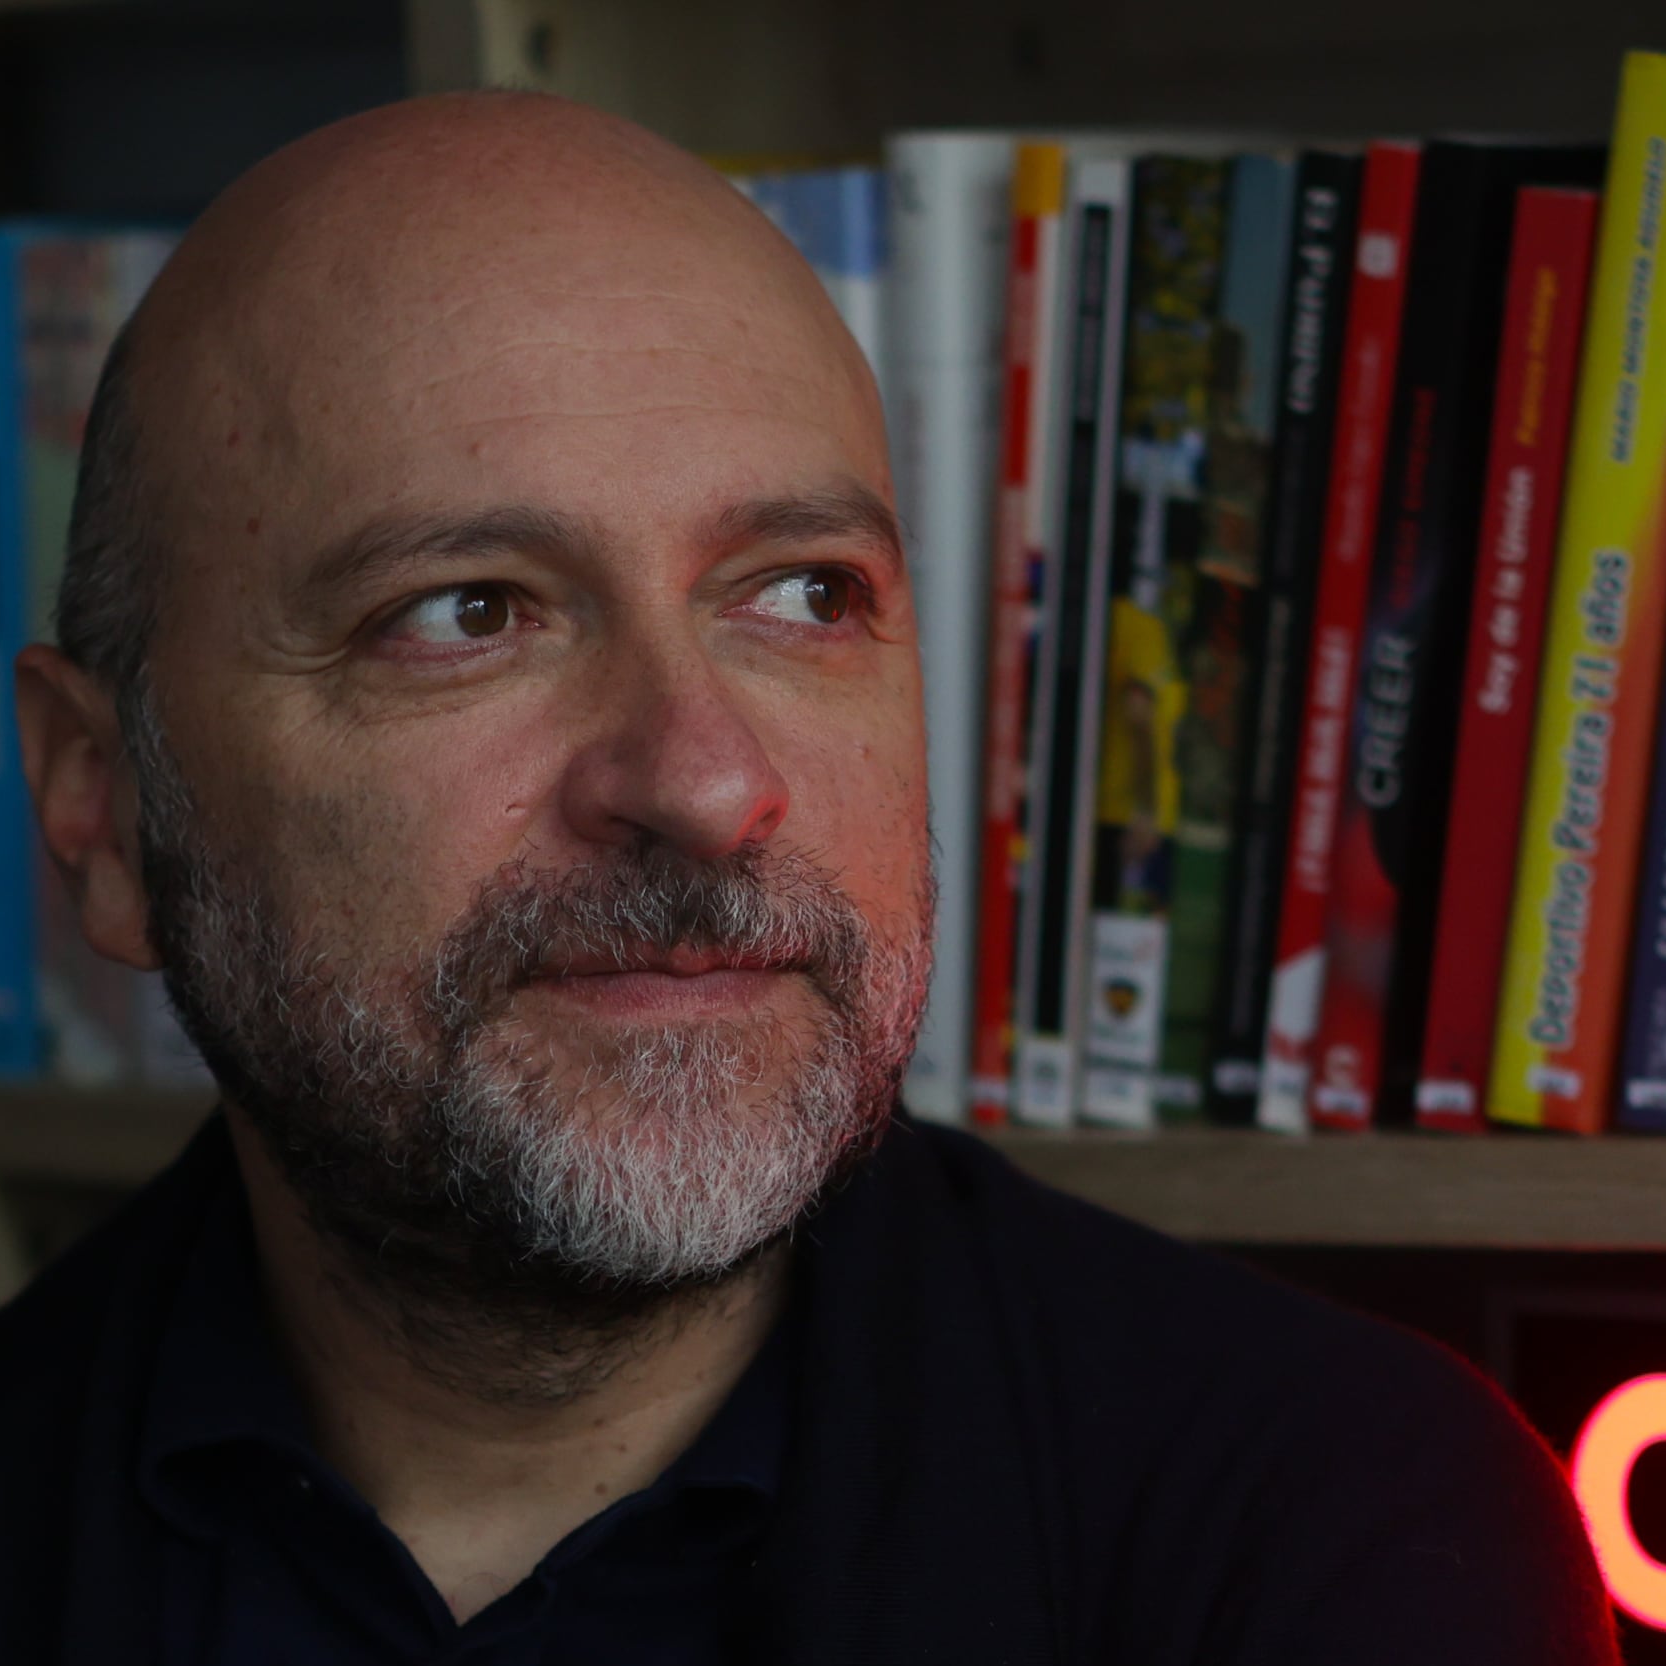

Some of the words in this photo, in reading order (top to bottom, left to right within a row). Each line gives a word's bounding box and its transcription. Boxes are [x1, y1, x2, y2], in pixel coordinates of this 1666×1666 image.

[1582, 550, 1630, 642] años
[1355, 632, 1417, 808] CREER
[1553, 712, 1607, 852] Pereira
[1528, 863, 1587, 1046] Deportivo
